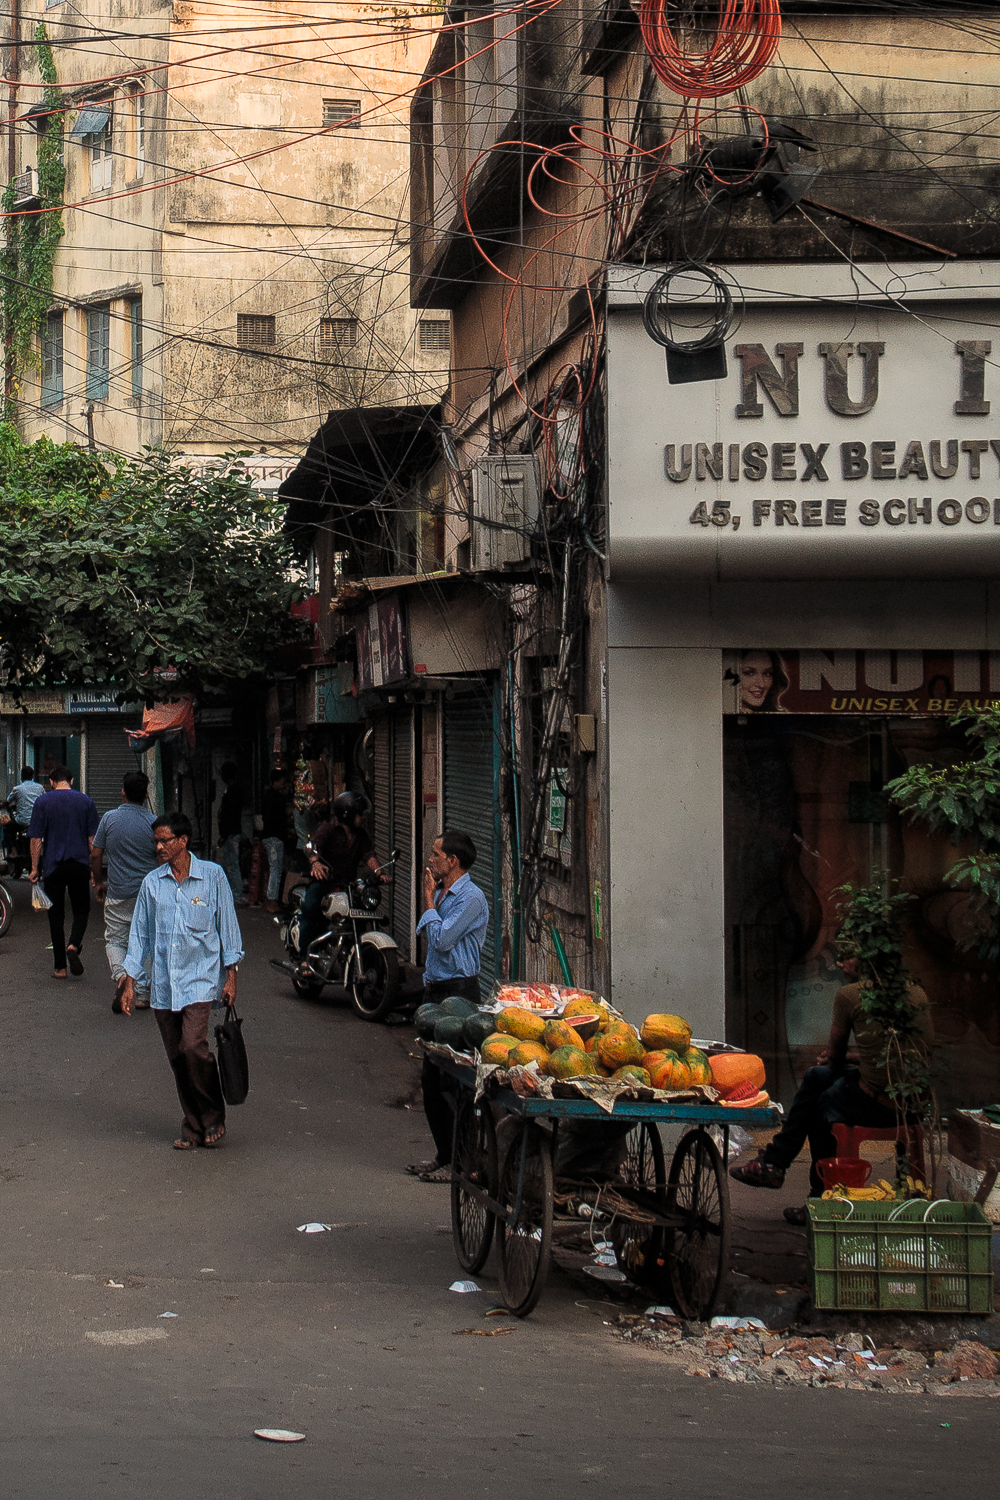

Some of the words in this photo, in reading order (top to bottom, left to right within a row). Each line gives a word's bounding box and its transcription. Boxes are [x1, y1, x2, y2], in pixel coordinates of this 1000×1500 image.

[734, 340, 886, 417] NU
[664, 440, 831, 482] UNISEX
[689, 500, 741, 530] 45,
[752, 498, 848, 527] FREE
[799, 650, 924, 692] NU
[830, 697, 920, 712] UNISEX
